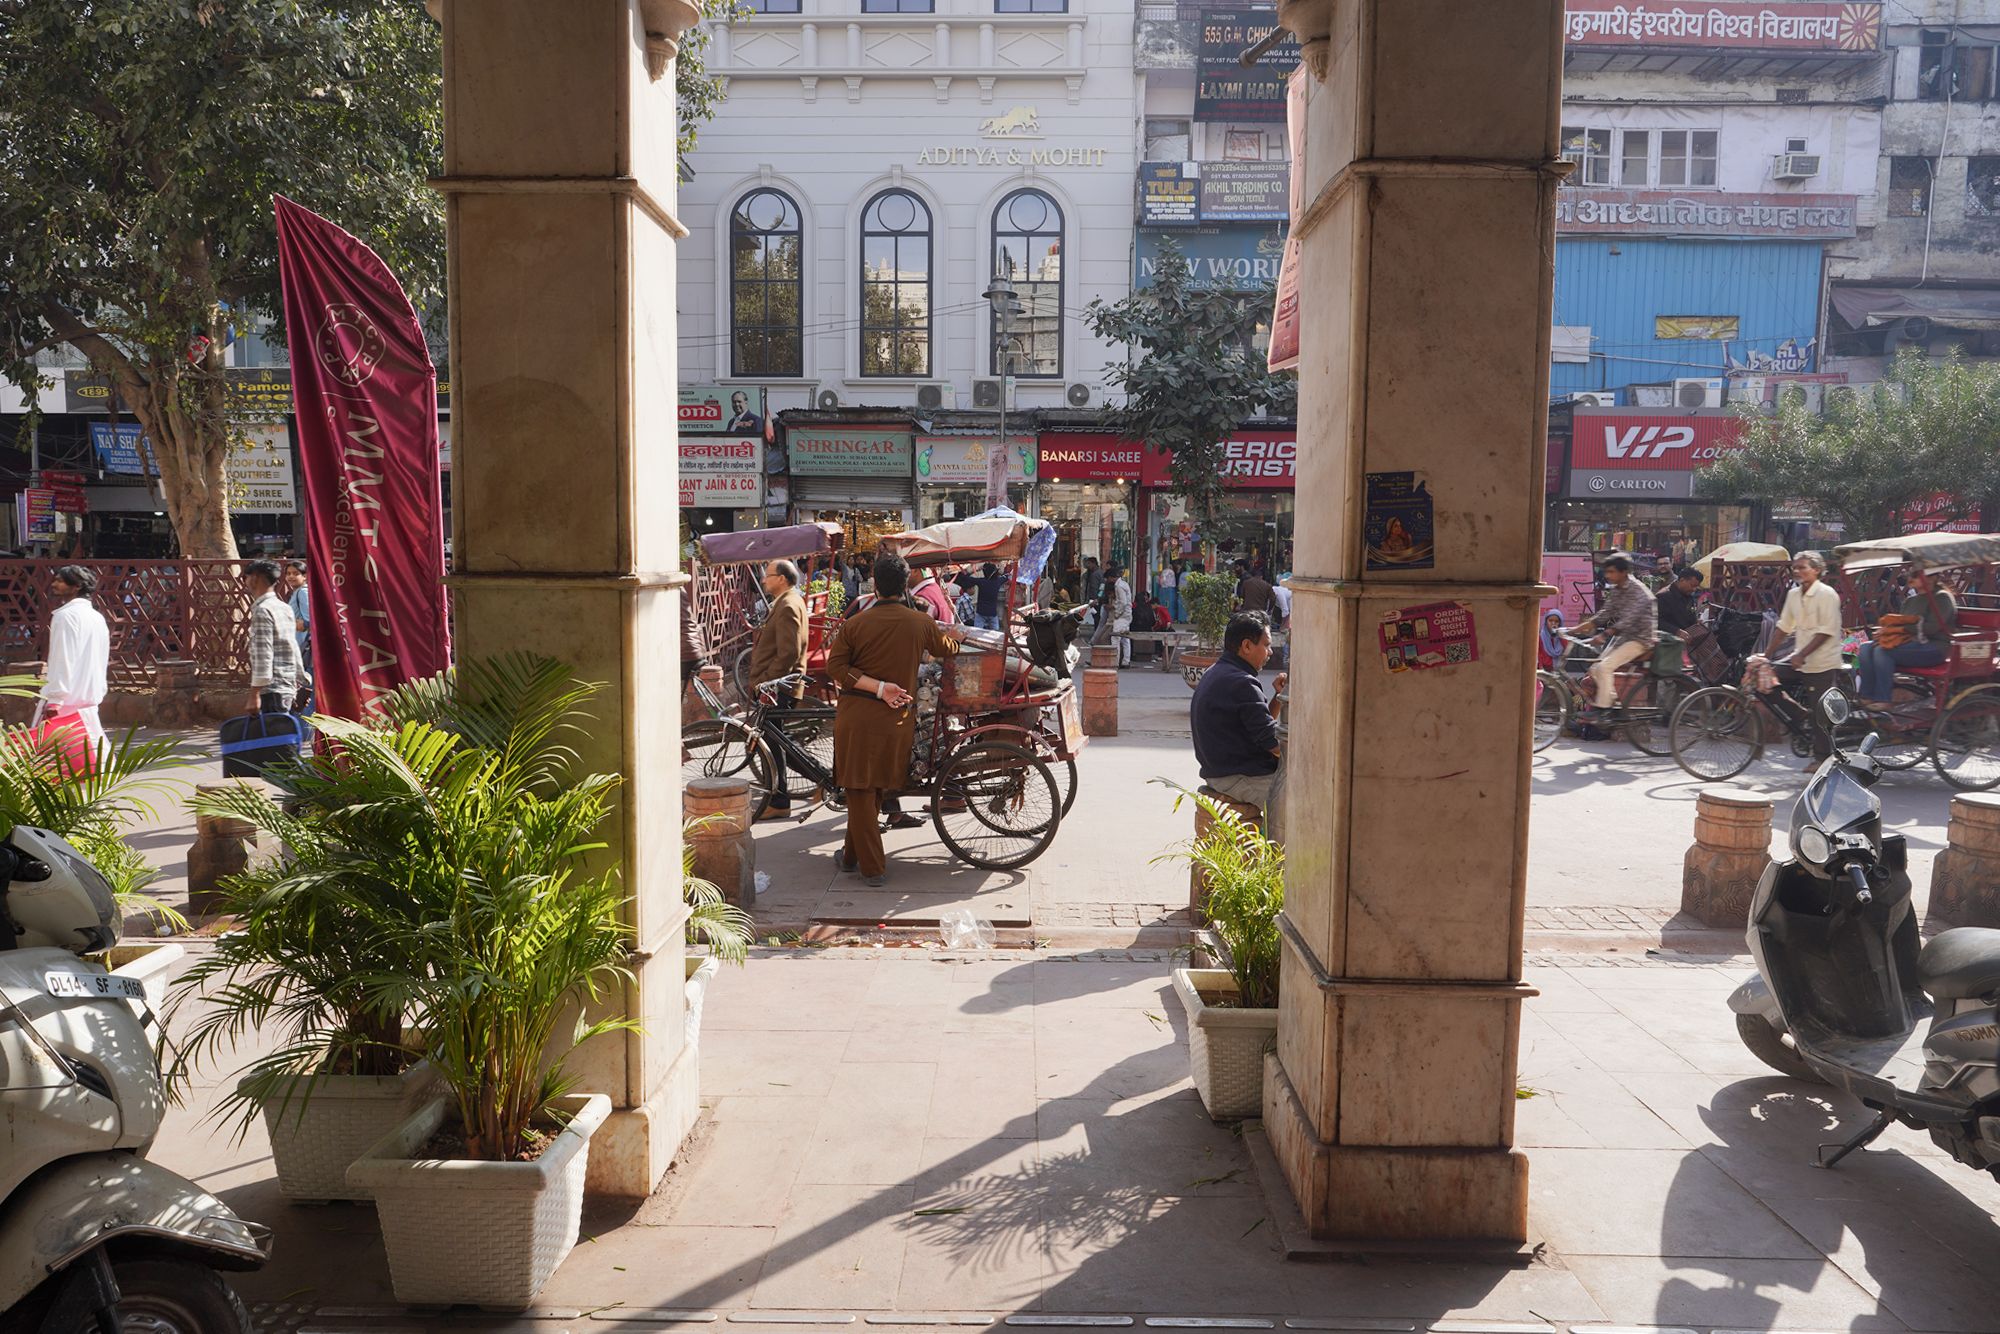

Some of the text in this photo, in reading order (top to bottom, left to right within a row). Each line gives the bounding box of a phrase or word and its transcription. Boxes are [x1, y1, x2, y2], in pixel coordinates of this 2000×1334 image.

[1205, 26, 1221, 43] 555
[1200, 82, 1241, 99] LAXMI
[1246, 82, 1279, 99] HARI
[916, 147, 1108, 166] ADITYA & MOHIT
[1147, 181, 1193, 194] TULIP
[1204, 182, 1284, 193] AKHIL TRADING CO.
[1140, 257, 1200, 277] NW
[796, 440, 895, 453] SHRINGAR
[1604, 426, 1695, 458] VIP
[1041, 450, 1141, 463] BANARSI SAREE
[705, 479, 727, 490] JAIN
[730, 479, 738, 490] &
[740, 479, 757, 490] CO.
[1610, 479, 1667, 489] CARLTON
[1435, 608, 1466, 618] ORDER
[1433, 615, 1467, 625] ONLINE
[1440, 622, 1468, 631] RIGHT
[1442, 628, 1469, 637] NOW!
[96, 978, 109, 993] SF
